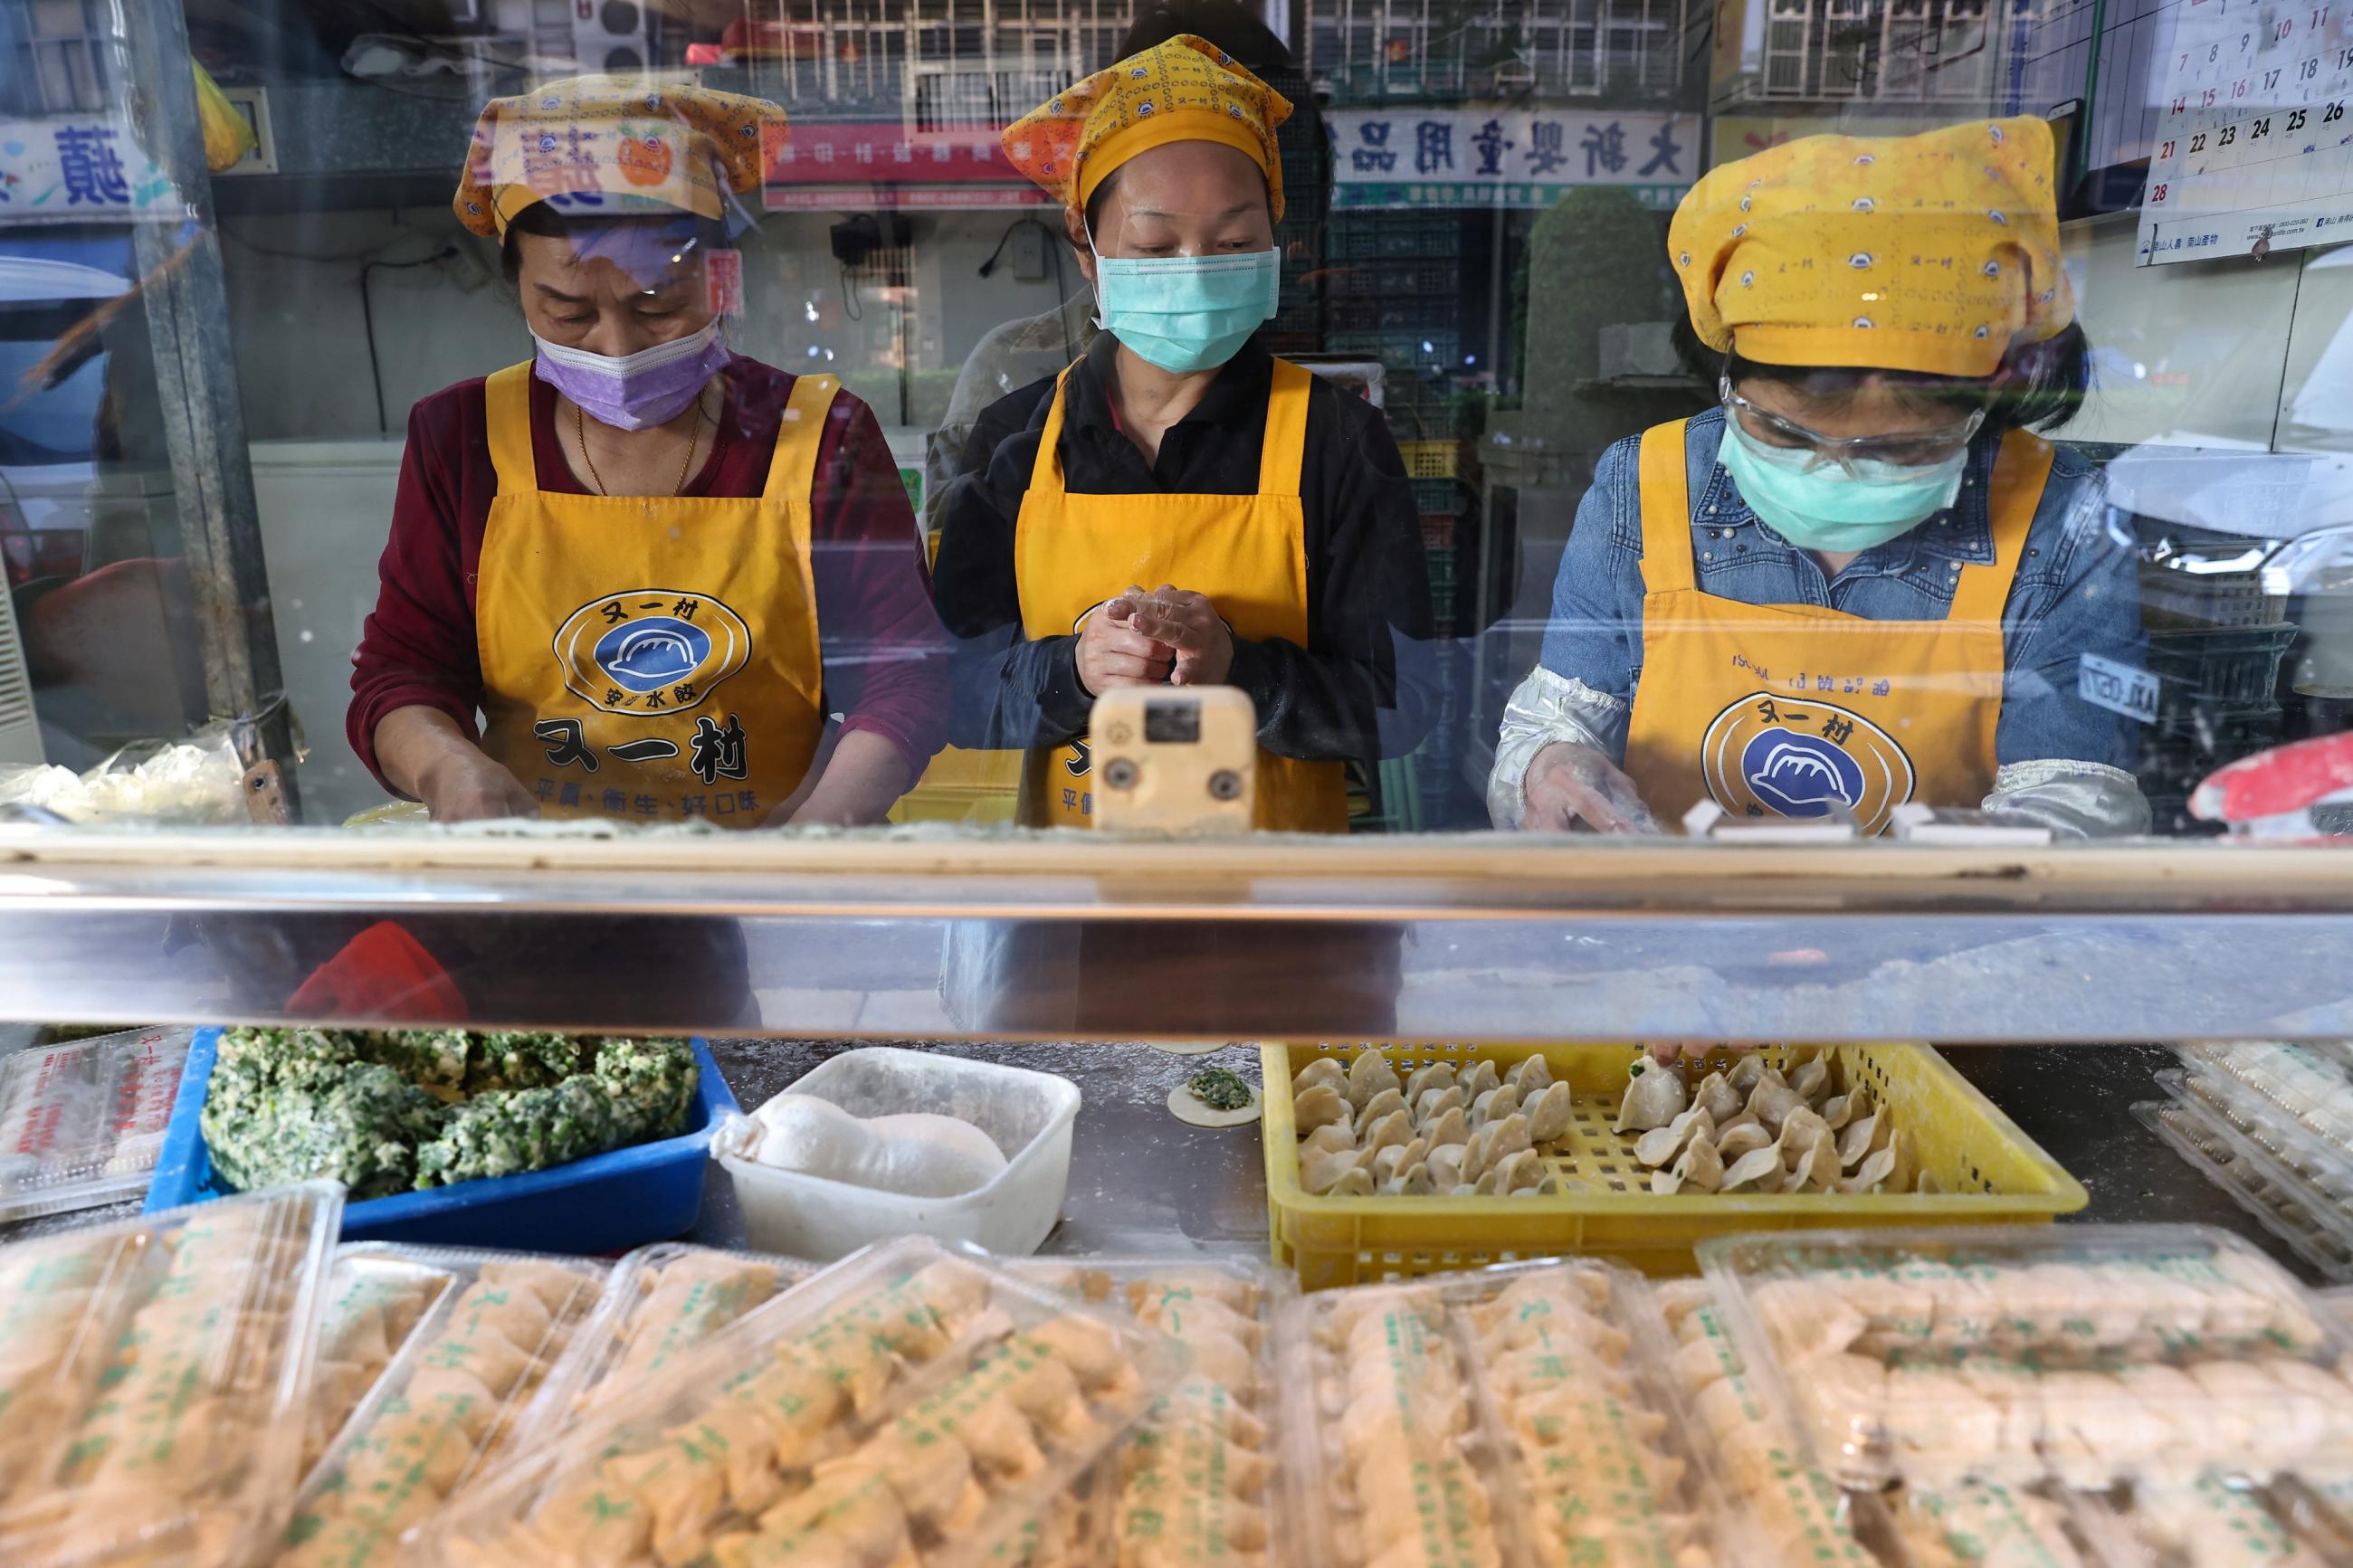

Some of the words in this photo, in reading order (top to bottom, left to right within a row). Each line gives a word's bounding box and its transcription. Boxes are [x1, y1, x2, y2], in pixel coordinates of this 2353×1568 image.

[2178, 53, 2188, 71] 7
[2208, 43, 2218, 63] 8
[2240, 33, 2251, 52] 9
[2274, 18, 2292, 42] 10
[2310, 6, 2329, 30] 11
[2171, 96, 2186, 116] 14
[2201, 88, 2215, 108] 15
[2231, 79, 2246, 100] 16
[2263, 68, 2282, 90] 17
[2300, 58, 2319, 81] 18
[2159, 140, 2176, 159] 21
[2188, 133, 2206, 154] 22
[2217, 125, 2236, 147] 23
[2251, 118, 2271, 139] 24
[2285, 109, 2307, 131] 25
[2322, 100, 2345, 123] 26
[2151, 184, 2167, 202] 28
[600, 597, 699, 624] 又一村
[533, 713, 748, 785] 又一村
[1757, 699, 1853, 746] 又一村
